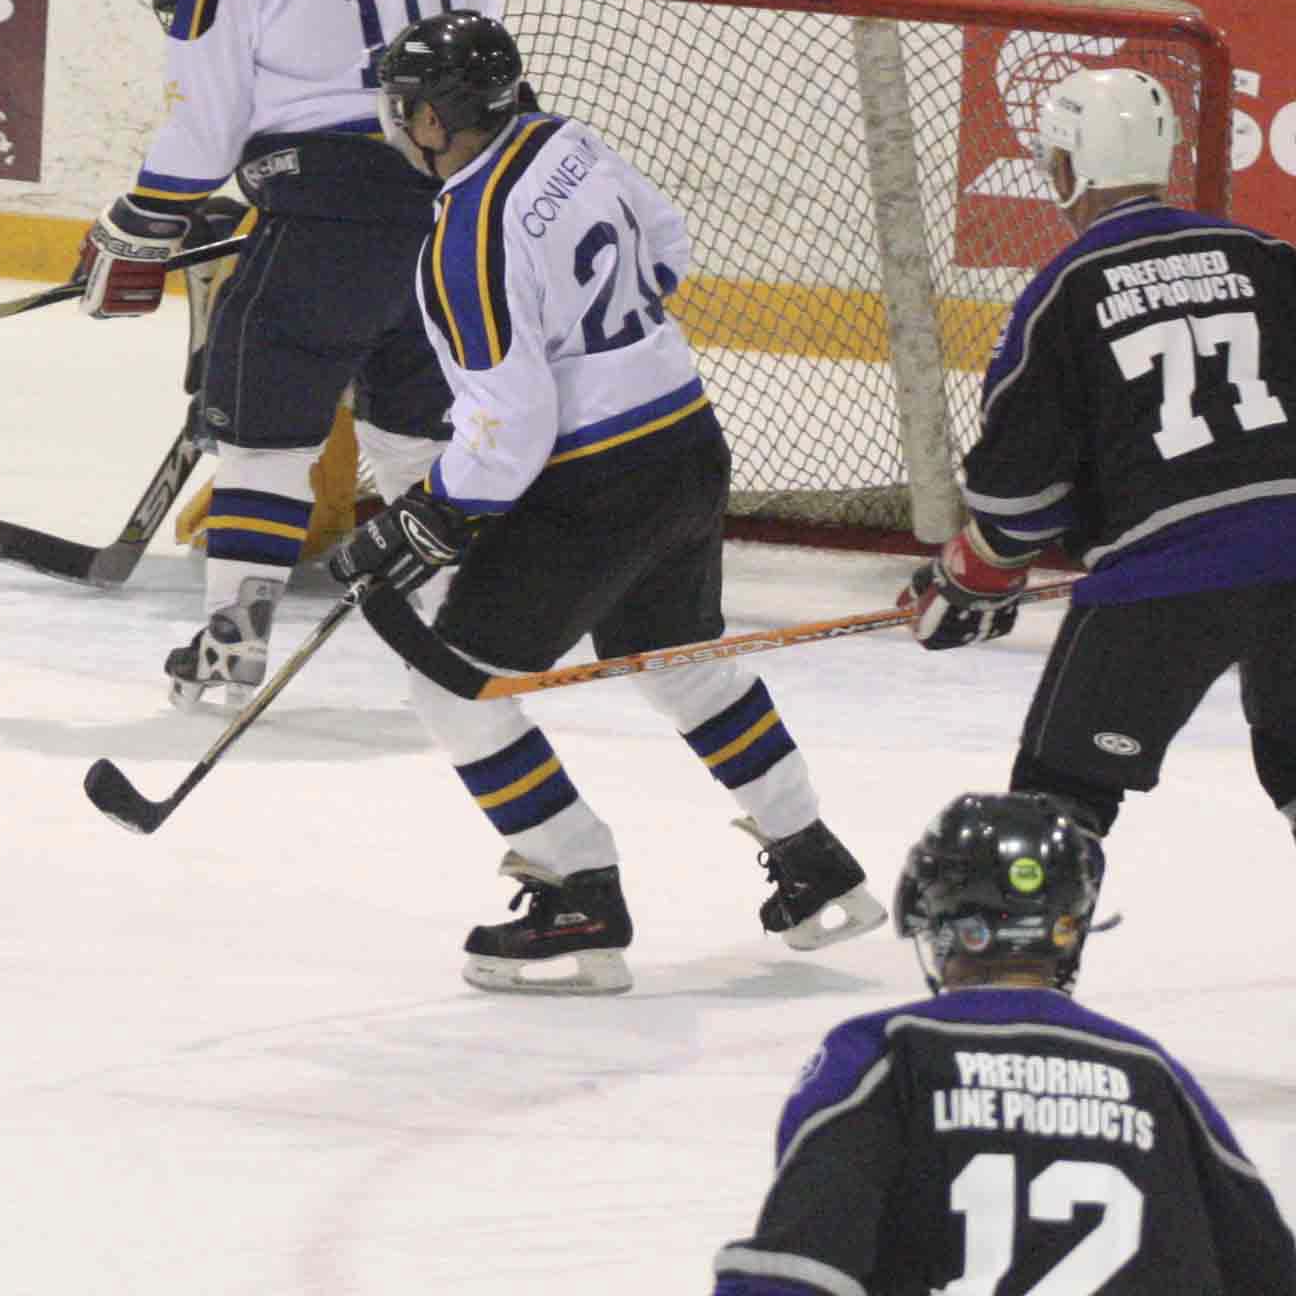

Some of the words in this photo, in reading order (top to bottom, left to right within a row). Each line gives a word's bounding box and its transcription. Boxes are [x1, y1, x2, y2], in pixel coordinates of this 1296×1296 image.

[1095, 287, 1148, 330] LINE
[1143, 272, 1256, 310] PRODUCTS
[1103, 250, 1231, 292] PREFORMED
[1110, 310, 1288, 461] 77
[955, 1051, 1131, 1103] PREFORMED
[933, 1087, 998, 1132] LINE
[1002, 1090, 1155, 1151] PRODUCTS
[929, 1152, 1145, 1296] 12
